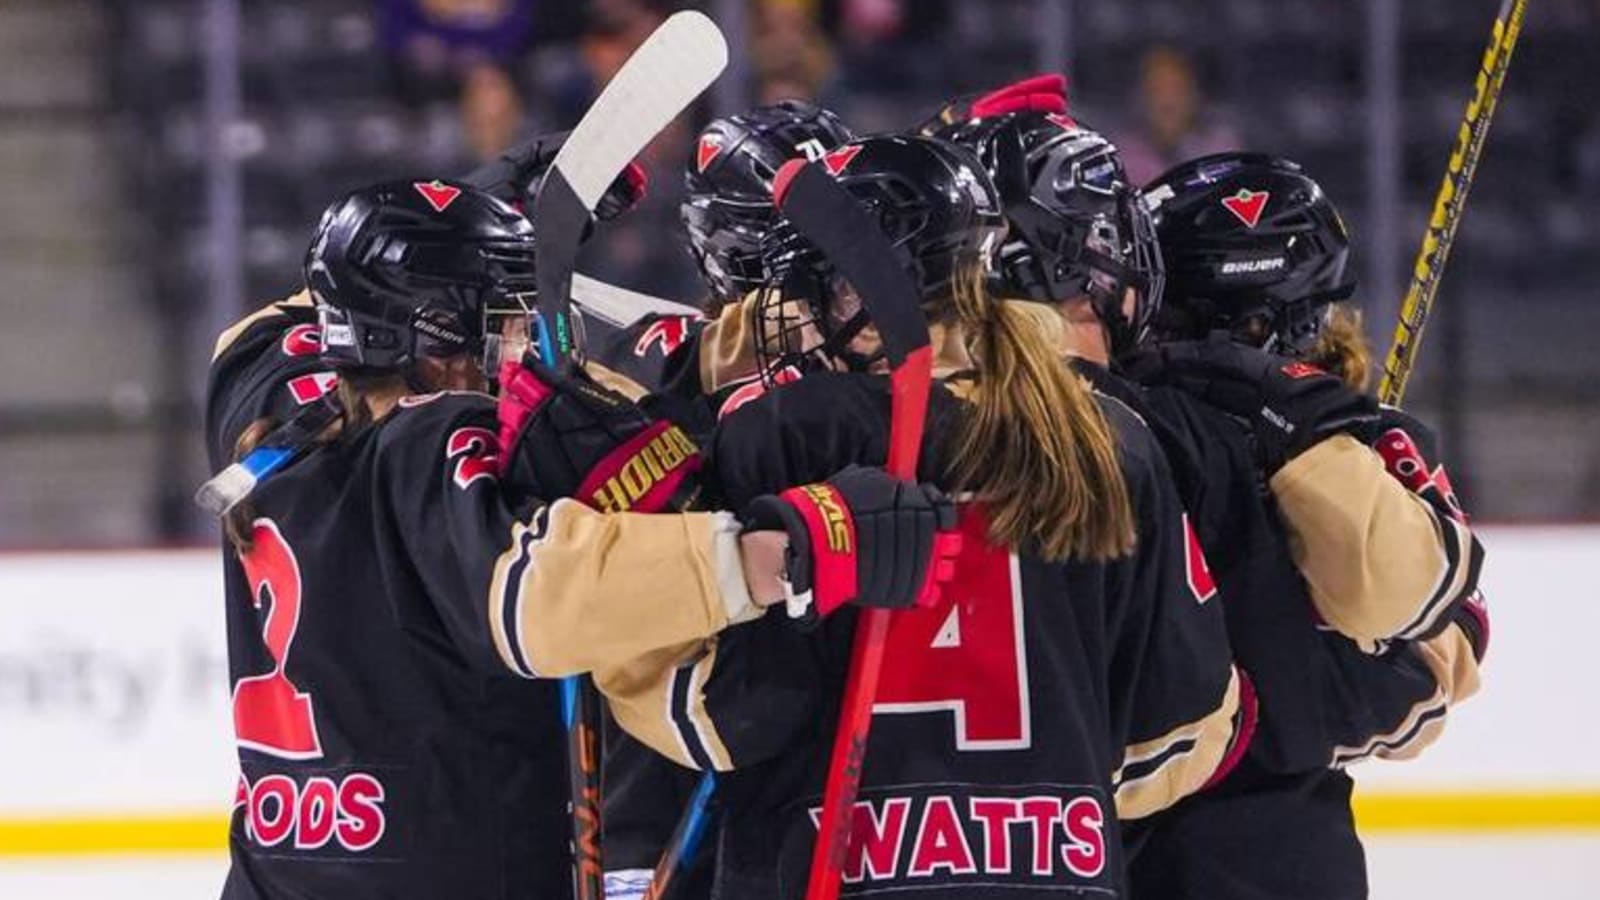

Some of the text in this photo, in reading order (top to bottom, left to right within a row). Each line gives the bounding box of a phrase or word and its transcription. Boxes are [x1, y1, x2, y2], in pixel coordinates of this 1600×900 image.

[447, 426, 500, 490] 2
[233, 517, 324, 759] 2
[235, 772, 385, 852] ODS
[810, 794, 1106, 882] WATTS
